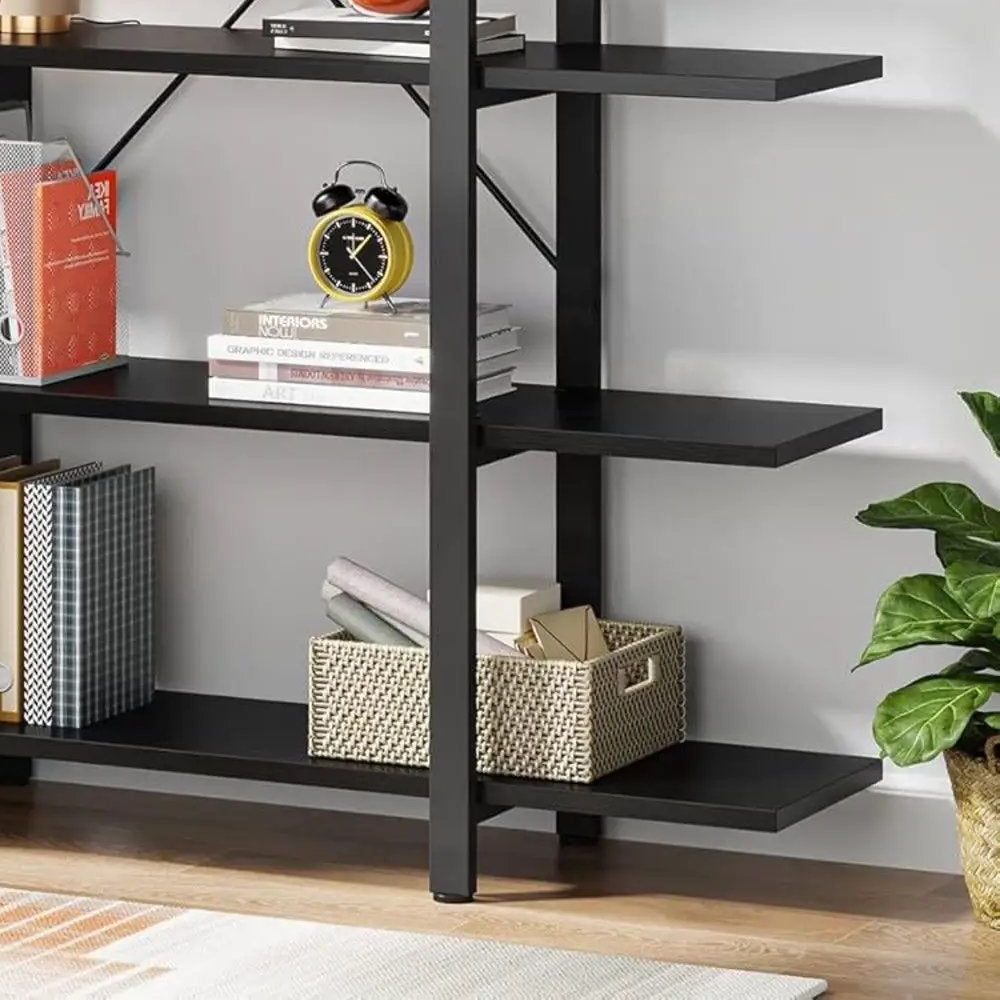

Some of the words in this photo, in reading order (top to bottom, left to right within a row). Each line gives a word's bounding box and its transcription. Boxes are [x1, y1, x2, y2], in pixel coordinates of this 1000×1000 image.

[258, 314, 328, 330] INTERIORS
[226, 344, 275, 357] GRAPHIC
[276, 347, 317, 359] DESIGN
